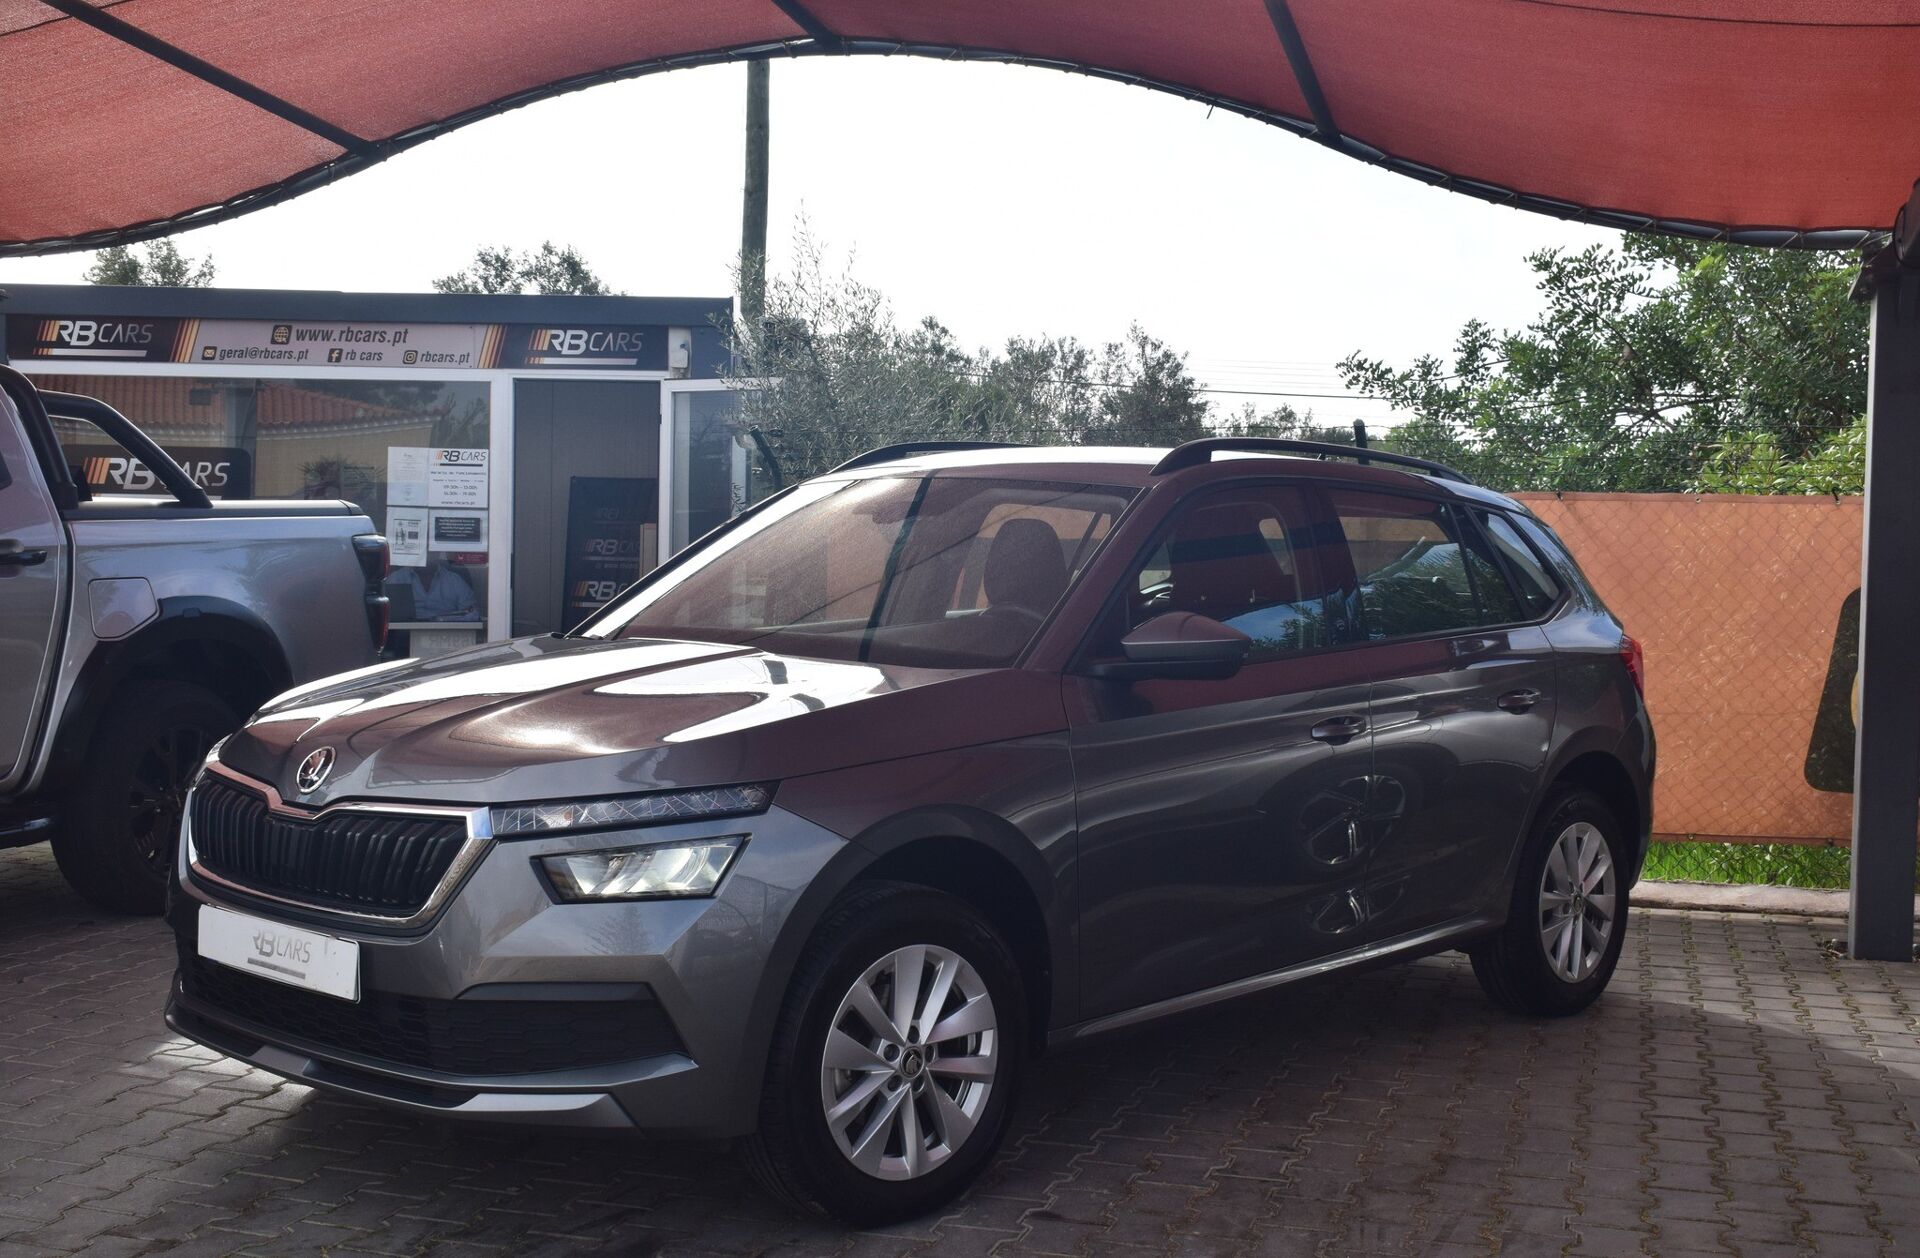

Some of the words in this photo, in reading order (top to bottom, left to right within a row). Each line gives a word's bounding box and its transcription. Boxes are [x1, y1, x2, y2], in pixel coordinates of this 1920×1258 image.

[47, 320, 98, 346] RB
[98, 323, 154, 343] CARS
[295, 326, 409, 347] www.rbcars.pt
[541, 329, 589, 355] RB
[589, 332, 644, 352] CARS
[218, 346, 309, 362] geral@rbcars.pt
[345, 349, 357, 361] rb
[359, 351, 384, 361] cars
[420, 351, 470, 365] rbcars.pt
[439, 450, 461, 462] RB
[460, 451, 487, 461] CARS
[276, 935, 312, 964] CARS
